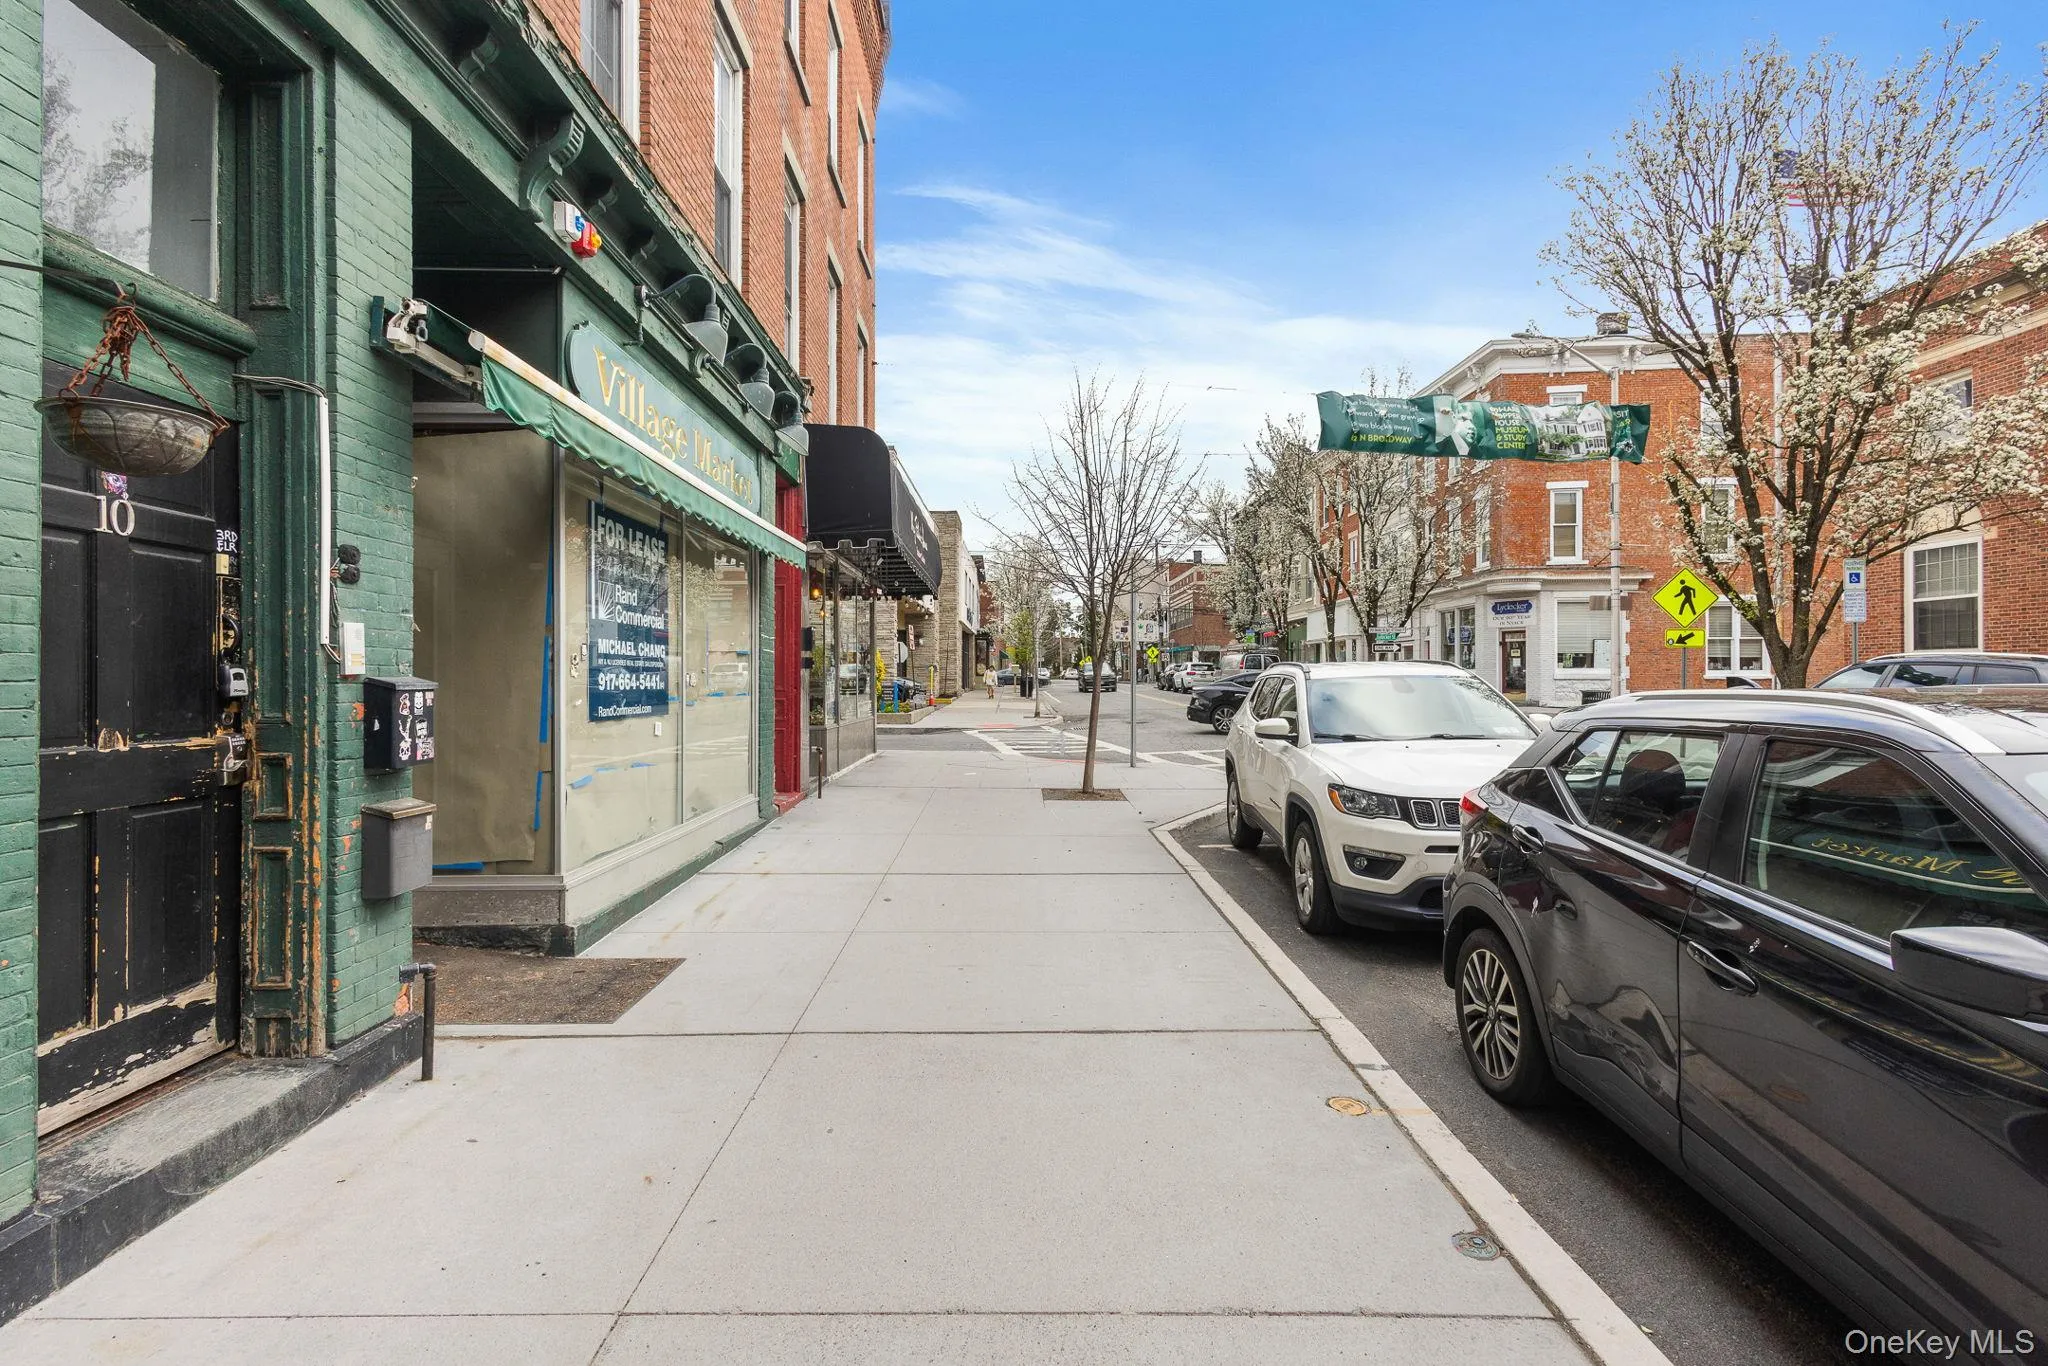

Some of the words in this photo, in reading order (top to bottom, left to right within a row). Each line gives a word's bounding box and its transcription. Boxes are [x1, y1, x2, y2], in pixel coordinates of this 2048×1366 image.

[593, 345, 688, 461] Village
[693, 428, 753, 505] Market
[1495, 426, 1529, 434] MUSEUM
[1497, 441, 1526, 450] CENTER
[1504, 434, 1527, 442] STUDY
[93, 495, 135, 537] 10
[216, 529, 238, 543] 3RD
[597, 515, 625, 551] FOR
[629, 528, 666, 565] LEASE
[217, 540, 238, 553] FLR
[615, 584, 638, 606] Rand
[615, 608, 665, 631] Commercial
[598, 639, 636, 656] MICHAEL
[638, 642, 666, 659] CHANG
[598, 704, 652, 717] RandCommercial.com
